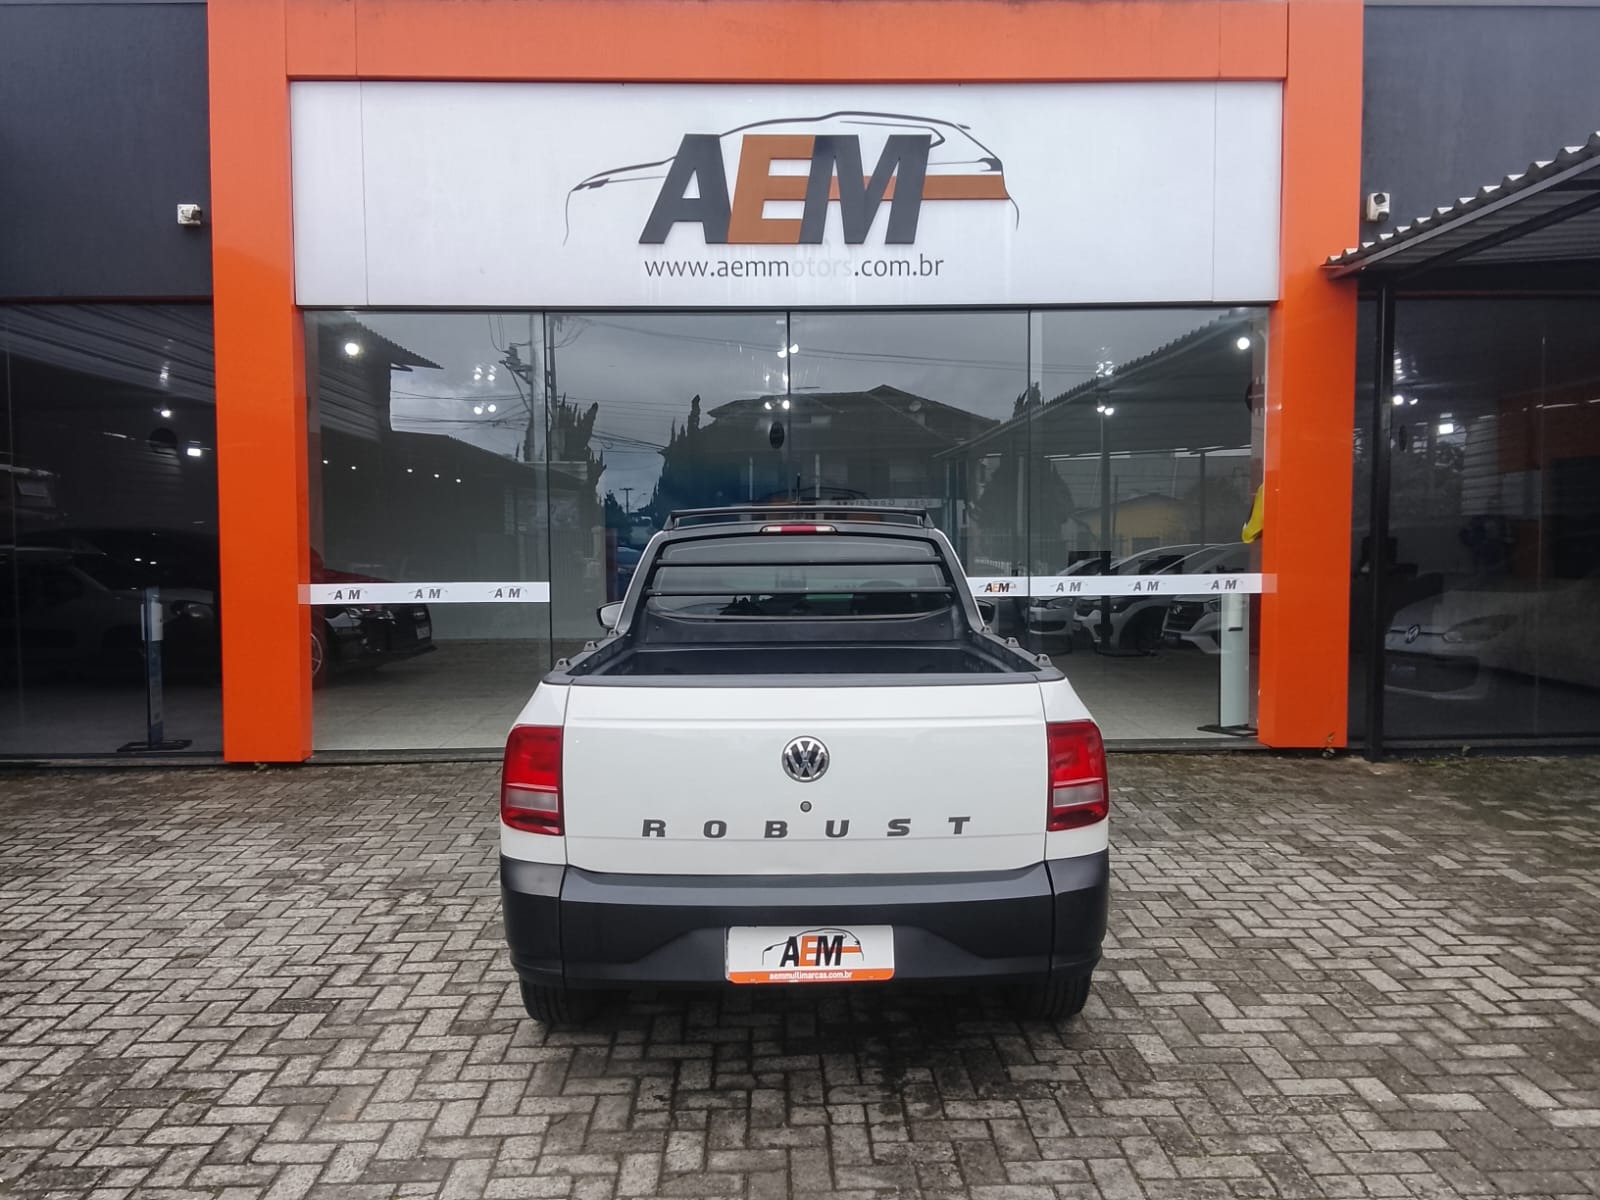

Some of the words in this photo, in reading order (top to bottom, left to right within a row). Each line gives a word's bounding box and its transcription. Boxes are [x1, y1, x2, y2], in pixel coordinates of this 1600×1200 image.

[638, 133, 932, 245] AEM
[644, 254, 944, 278] www.aemmotors.com.br
[984, 582, 1010, 593] AEM
[643, 817, 970, 838] ROBUST
[779, 934, 844, 967] AEM
